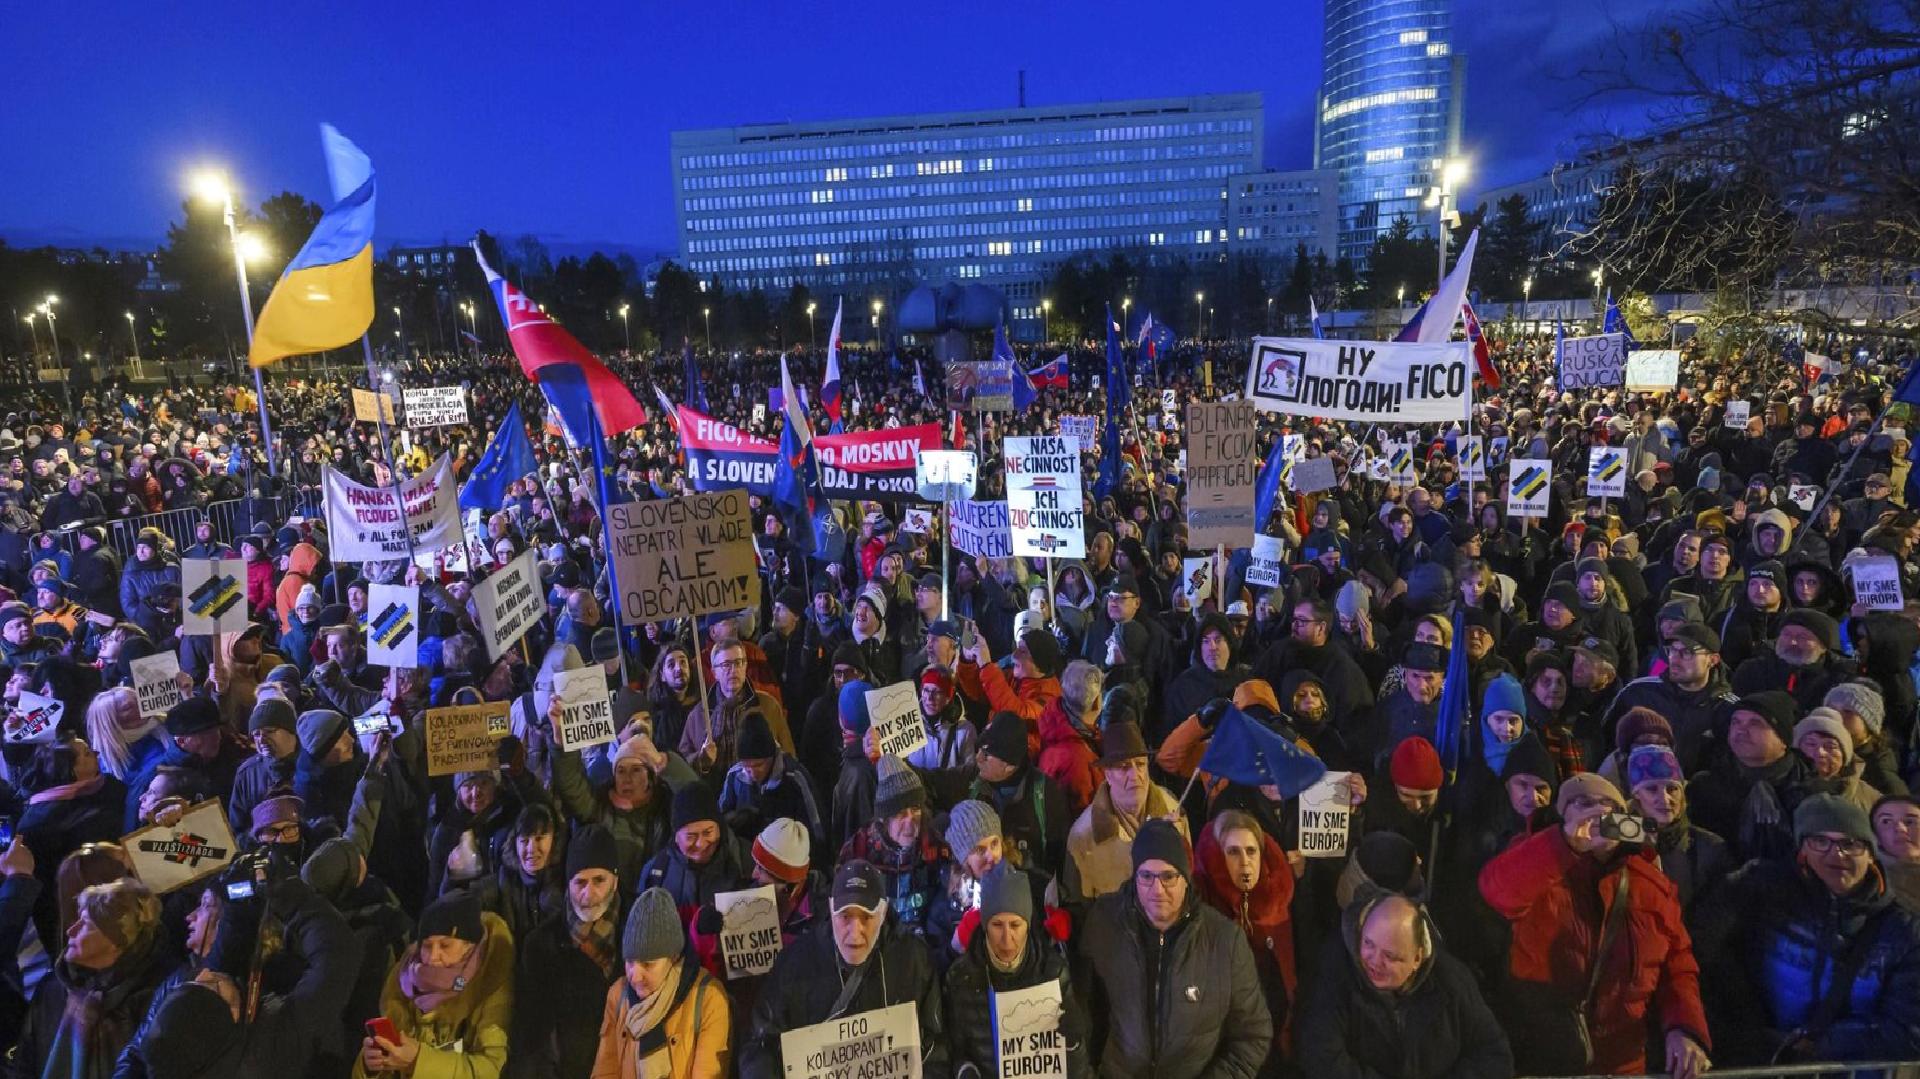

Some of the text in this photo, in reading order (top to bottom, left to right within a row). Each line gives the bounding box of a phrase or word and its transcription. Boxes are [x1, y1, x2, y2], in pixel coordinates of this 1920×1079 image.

[1337, 346, 1376, 376] НУ
[1563, 348, 1620, 371] RUSKÁ
[1407, 361, 1466, 399] FICO
[1562, 370, 1621, 388] ONUCA
[1301, 375, 1402, 413] ПОГОДИ!
[1190, 402, 1255, 434] BLANÁR
[697, 418, 742, 447] FICO,
[842, 439, 920, 465] MOSKVY
[1031, 438, 1065, 455] NAŠA
[1205, 434, 1254, 460] FICOV
[688, 458, 700, 478] A
[1006, 454, 1076, 473] NEČINNOSŤ
[1188, 460, 1253, 488] PAPAGÁJ
[824, 467, 858, 488] DAJ
[347, 487, 394, 506] HANBA
[1036, 491, 1058, 509] ICH
[611, 494, 738, 530] SLOVENSKO
[1011, 506, 1083, 529] ZLOČINNOSŤ
[371, 531, 388, 542] ALL
[413, 519, 433, 534] JAN
[616, 518, 748, 557] NEPATRÍ VLÁDE
[657, 550, 717, 584] ALE
[627, 575, 749, 618] OBČANOM!
[1856, 579, 1897, 593] MY SME
[138, 683, 155, 698] MY
[562, 700, 609, 725] MY SME
[875, 708, 920, 739] MY SME
[565, 719, 613, 745] EURÓPA
[881, 725, 924, 755] EURÓPA
[1302, 810, 1347, 829] MY SME
[1302, 828, 1345, 850] EURÓPA
[725, 926, 778, 952] MY SME
[839, 1018, 868, 1041] FICO
[1003, 1029, 1061, 1056] MY SME
[1003, 1051, 1062, 1079] EURÓPA
